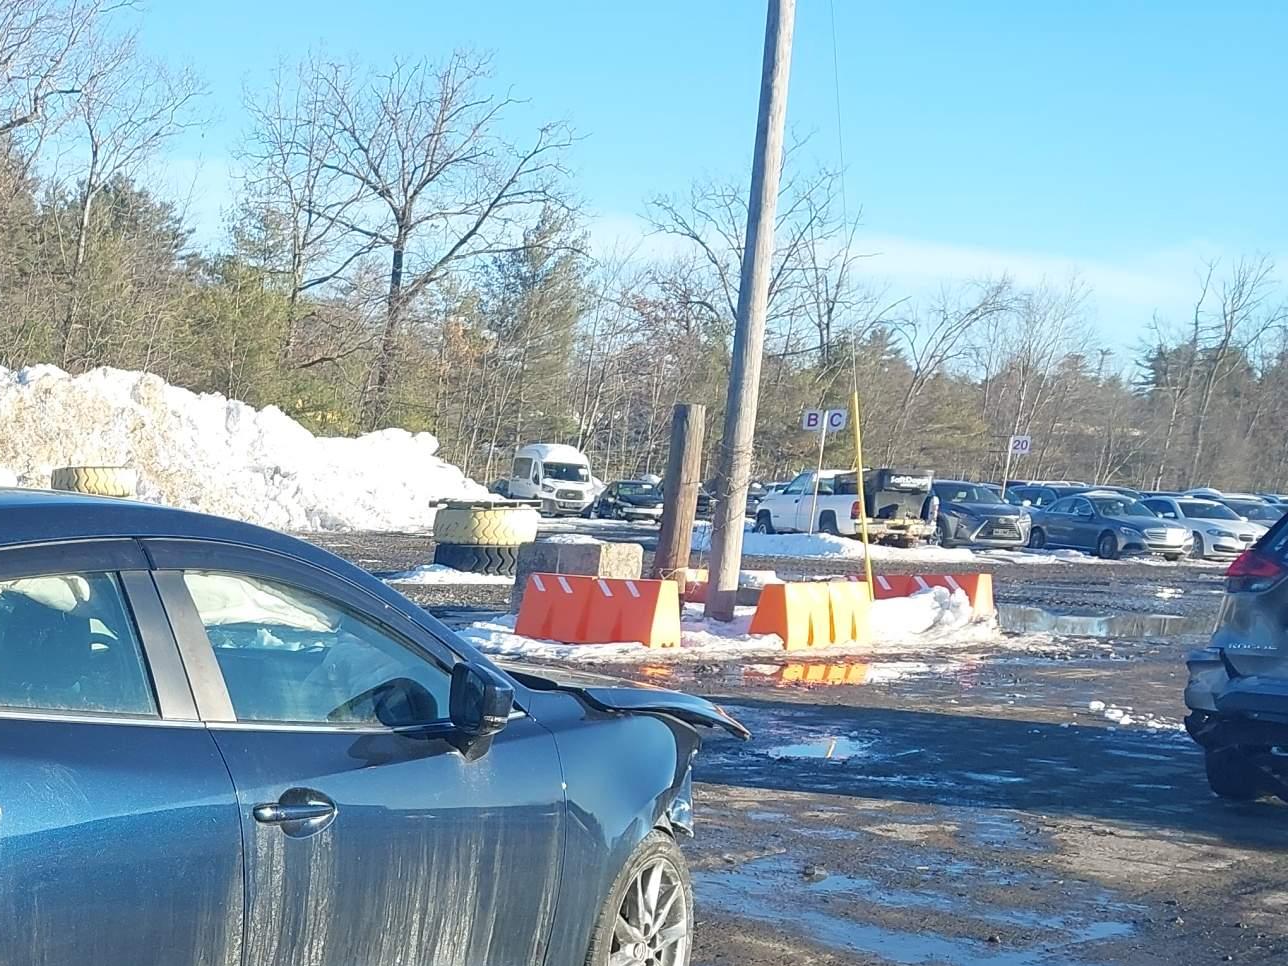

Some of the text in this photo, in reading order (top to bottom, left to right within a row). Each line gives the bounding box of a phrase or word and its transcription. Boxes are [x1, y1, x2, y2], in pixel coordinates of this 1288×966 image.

[807, 412, 818, 427] B
[830, 412, 842, 427] C
[1013, 439, 1028, 450] 20
